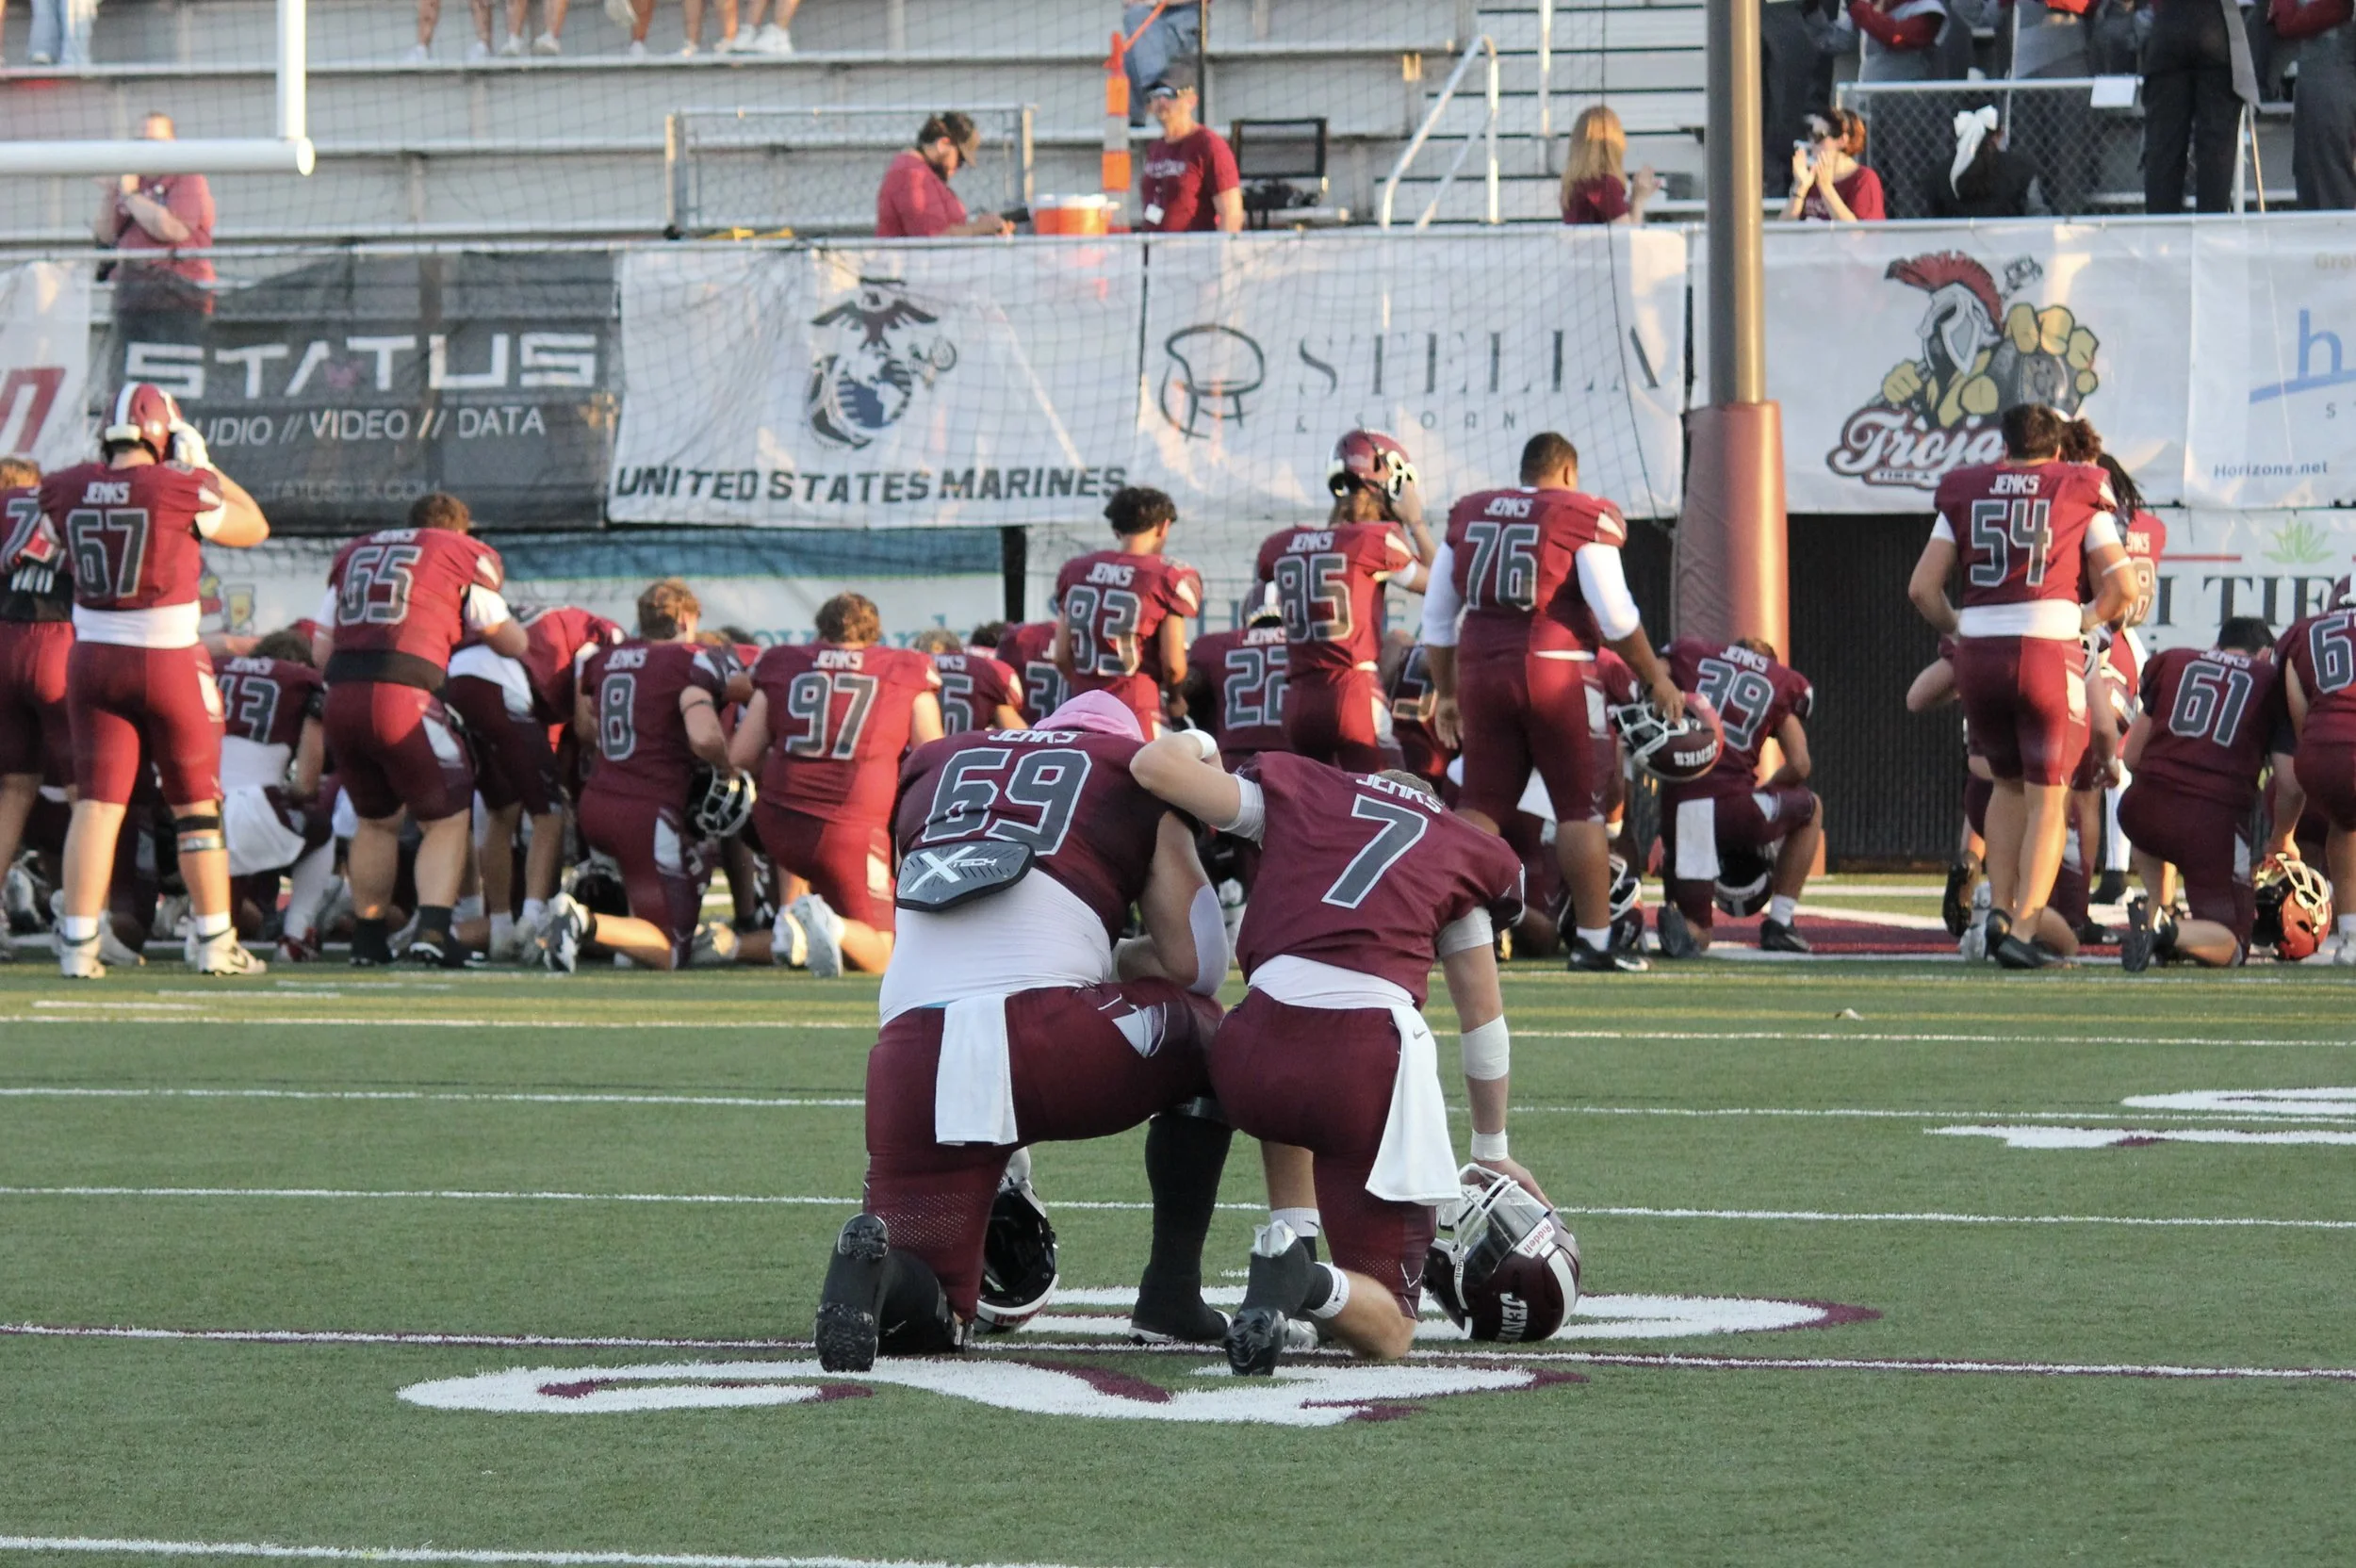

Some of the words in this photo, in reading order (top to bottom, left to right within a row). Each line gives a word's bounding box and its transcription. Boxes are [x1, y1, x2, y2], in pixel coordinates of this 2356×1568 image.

[123, 333, 597, 400] STATUS
[1298, 325, 1661, 396] STELLA
[194, 416, 273, 446] UDIO
[309, 406, 409, 441] VIDEO
[458, 405, 546, 439] DATA
[1830, 409, 2005, 474] Troja
[82, 482, 131, 505] JENKS
[614, 466, 757, 501] UNITED
[766, 470, 932, 503] STATES
[939, 466, 1128, 501] MARINES
[1483, 497, 1535, 518] JENKS
[1988, 474, 2040, 496] JENKS
[66, 508, 149, 597] 67
[1085, 562, 1137, 587] JENKS
[1285, 531, 1335, 554] JENKS
[1464, 521, 1540, 612] 76
[1970, 498, 2053, 588] 54
[337, 545, 423, 626] 65
[1273, 552, 1354, 645] 85
[811, 649, 865, 671] JENKS
[1720, 645, 1772, 673] JENKS
[599, 672, 638, 761] 8
[785, 671, 879, 760] 97
[2168, 660, 2254, 748] 61
[988, 729, 1084, 745] JENKS
[920, 747, 1093, 857] 69
[1355, 773, 1446, 815] JENKS
[1321, 792, 1429, 910] 7
[1524, 1222, 1553, 1254] Riddell
